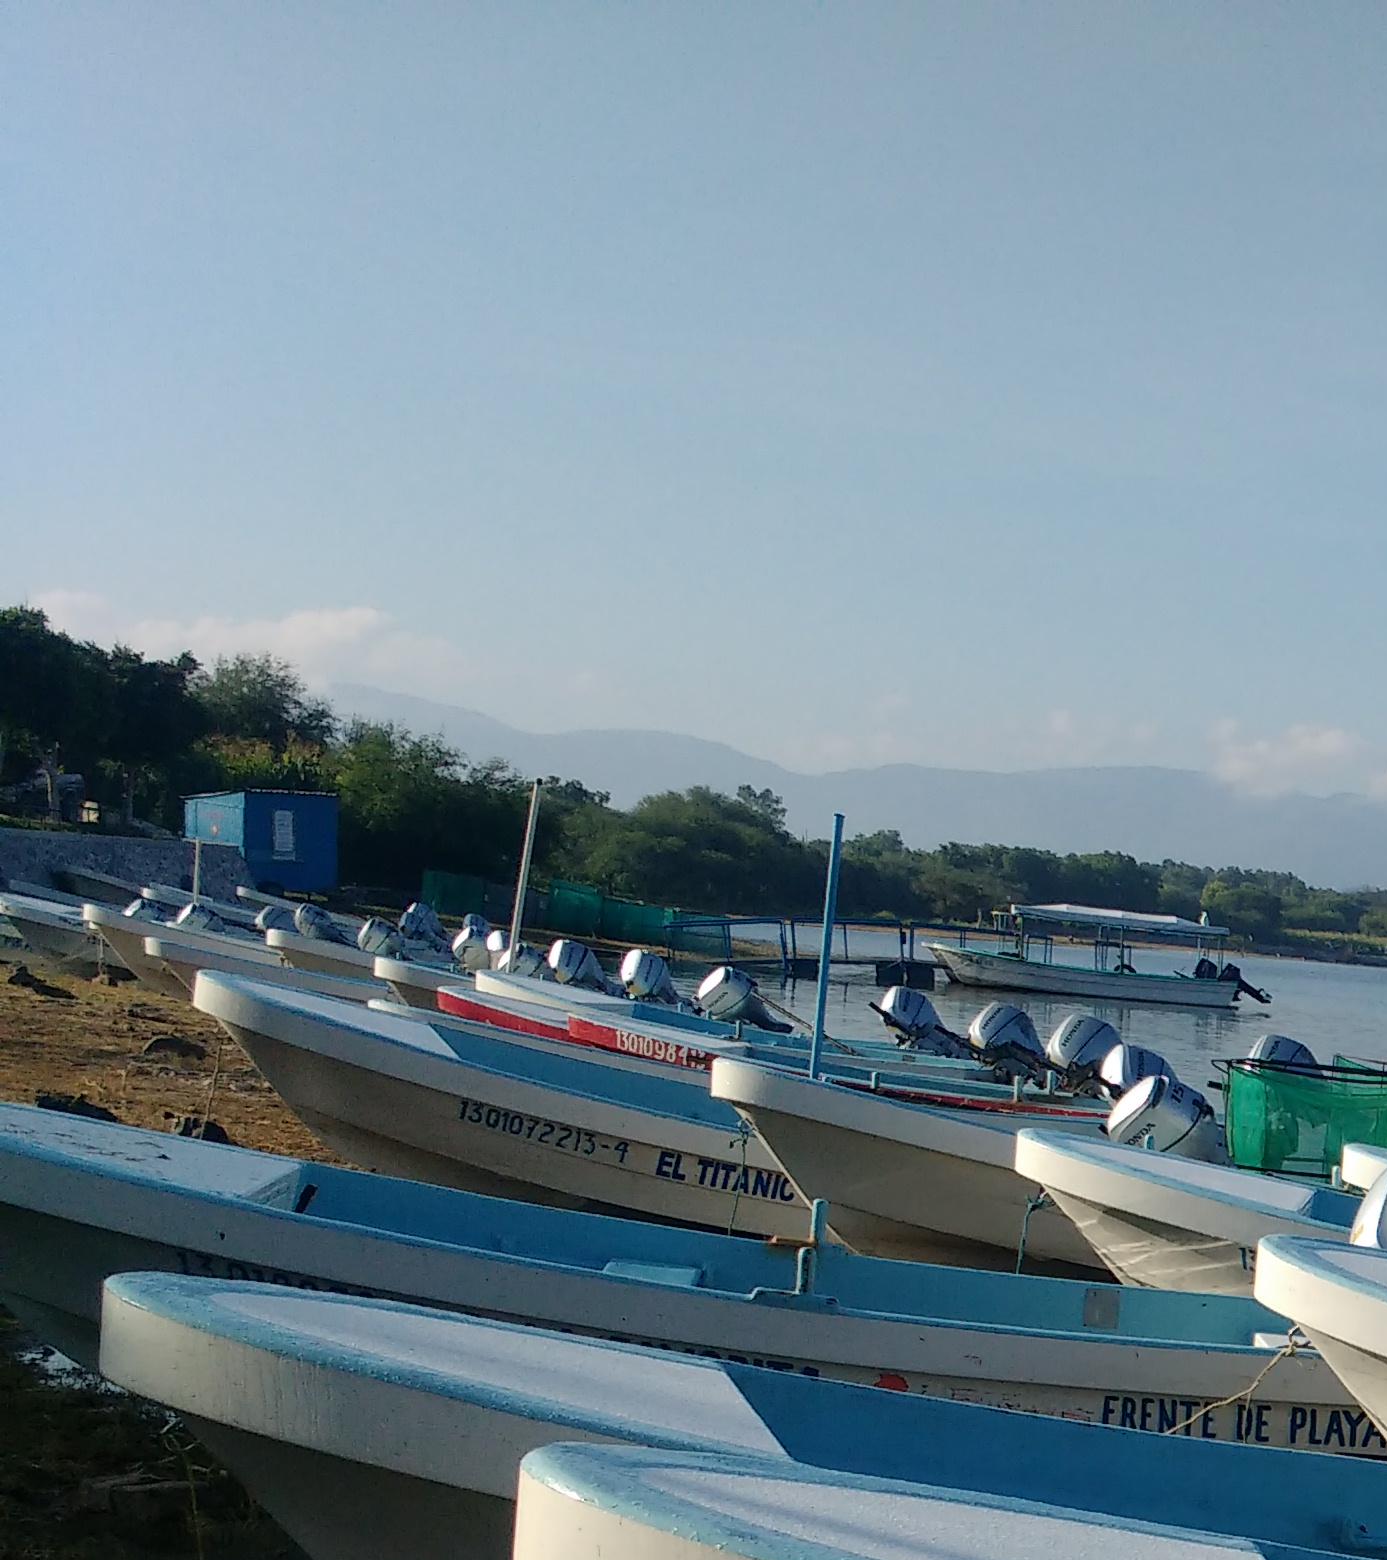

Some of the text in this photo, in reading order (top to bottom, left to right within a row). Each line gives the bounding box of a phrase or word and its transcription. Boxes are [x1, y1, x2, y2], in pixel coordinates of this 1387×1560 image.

[1061, 1018, 1085, 1048] HONDA
[1123, 1122, 1157, 1147] ONDA
[655, 1151, 796, 1203] EL TITANIC
[1102, 1395, 1217, 1439] FRENTE
[1236, 1404, 1273, 1442] DE
[1289, 1406, 1387, 1449] PLAYA
